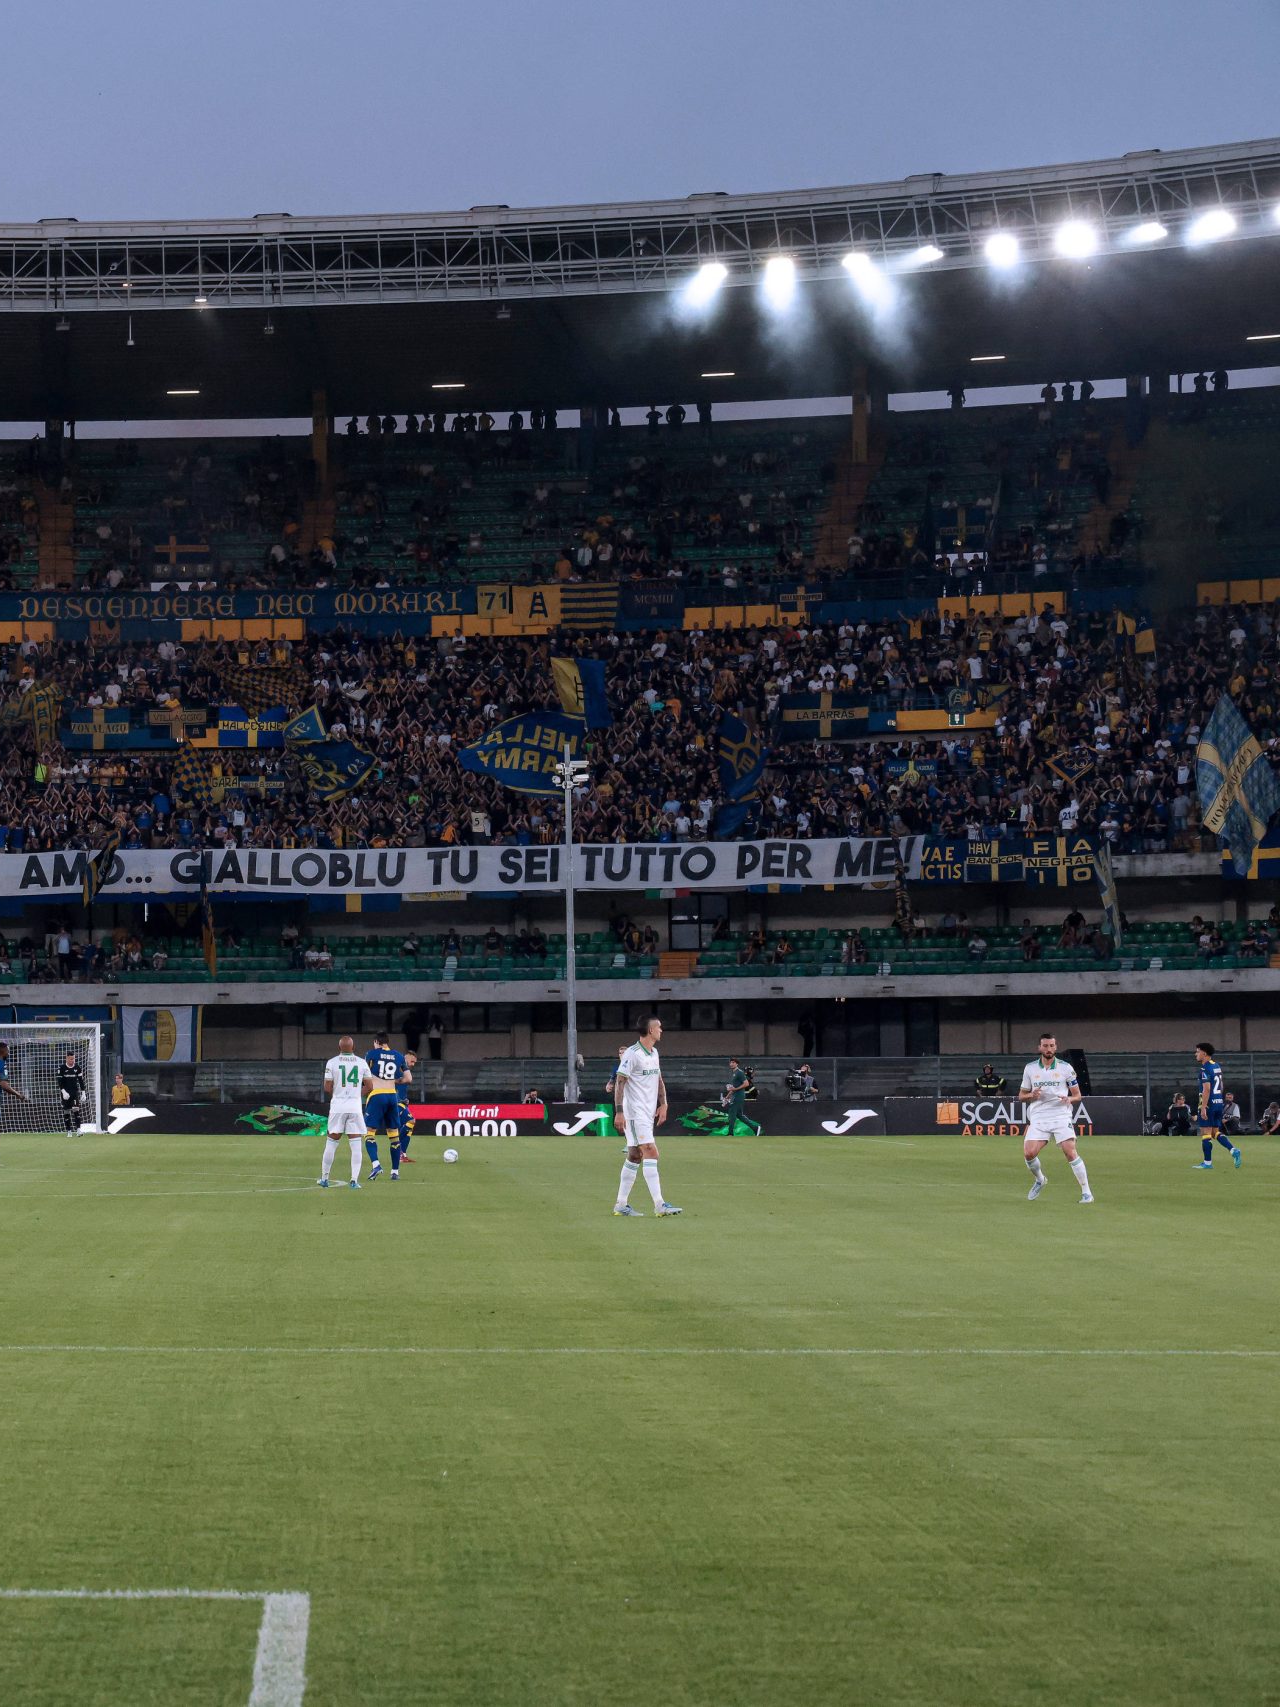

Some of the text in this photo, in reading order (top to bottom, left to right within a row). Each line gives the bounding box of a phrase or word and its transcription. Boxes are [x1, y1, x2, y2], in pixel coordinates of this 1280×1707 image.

[796, 709, 856, 720] LA BARRAS
[169, 850, 407, 887] GIALLOBLU
[426, 849, 479, 885] TU
[498, 847, 560, 884] SEI
[580, 846, 717, 882] TUTTO
[736, 842, 813, 880] PER
[833, 836, 915, 878] ME!
[967, 854, 1024, 865] BANGKOK
[921, 863, 962, 880] ICTIS
[338, 1064, 360, 1088] 14
[377, 1060, 397, 1079] 18
[435, 1119, 518, 1137] 00:00
